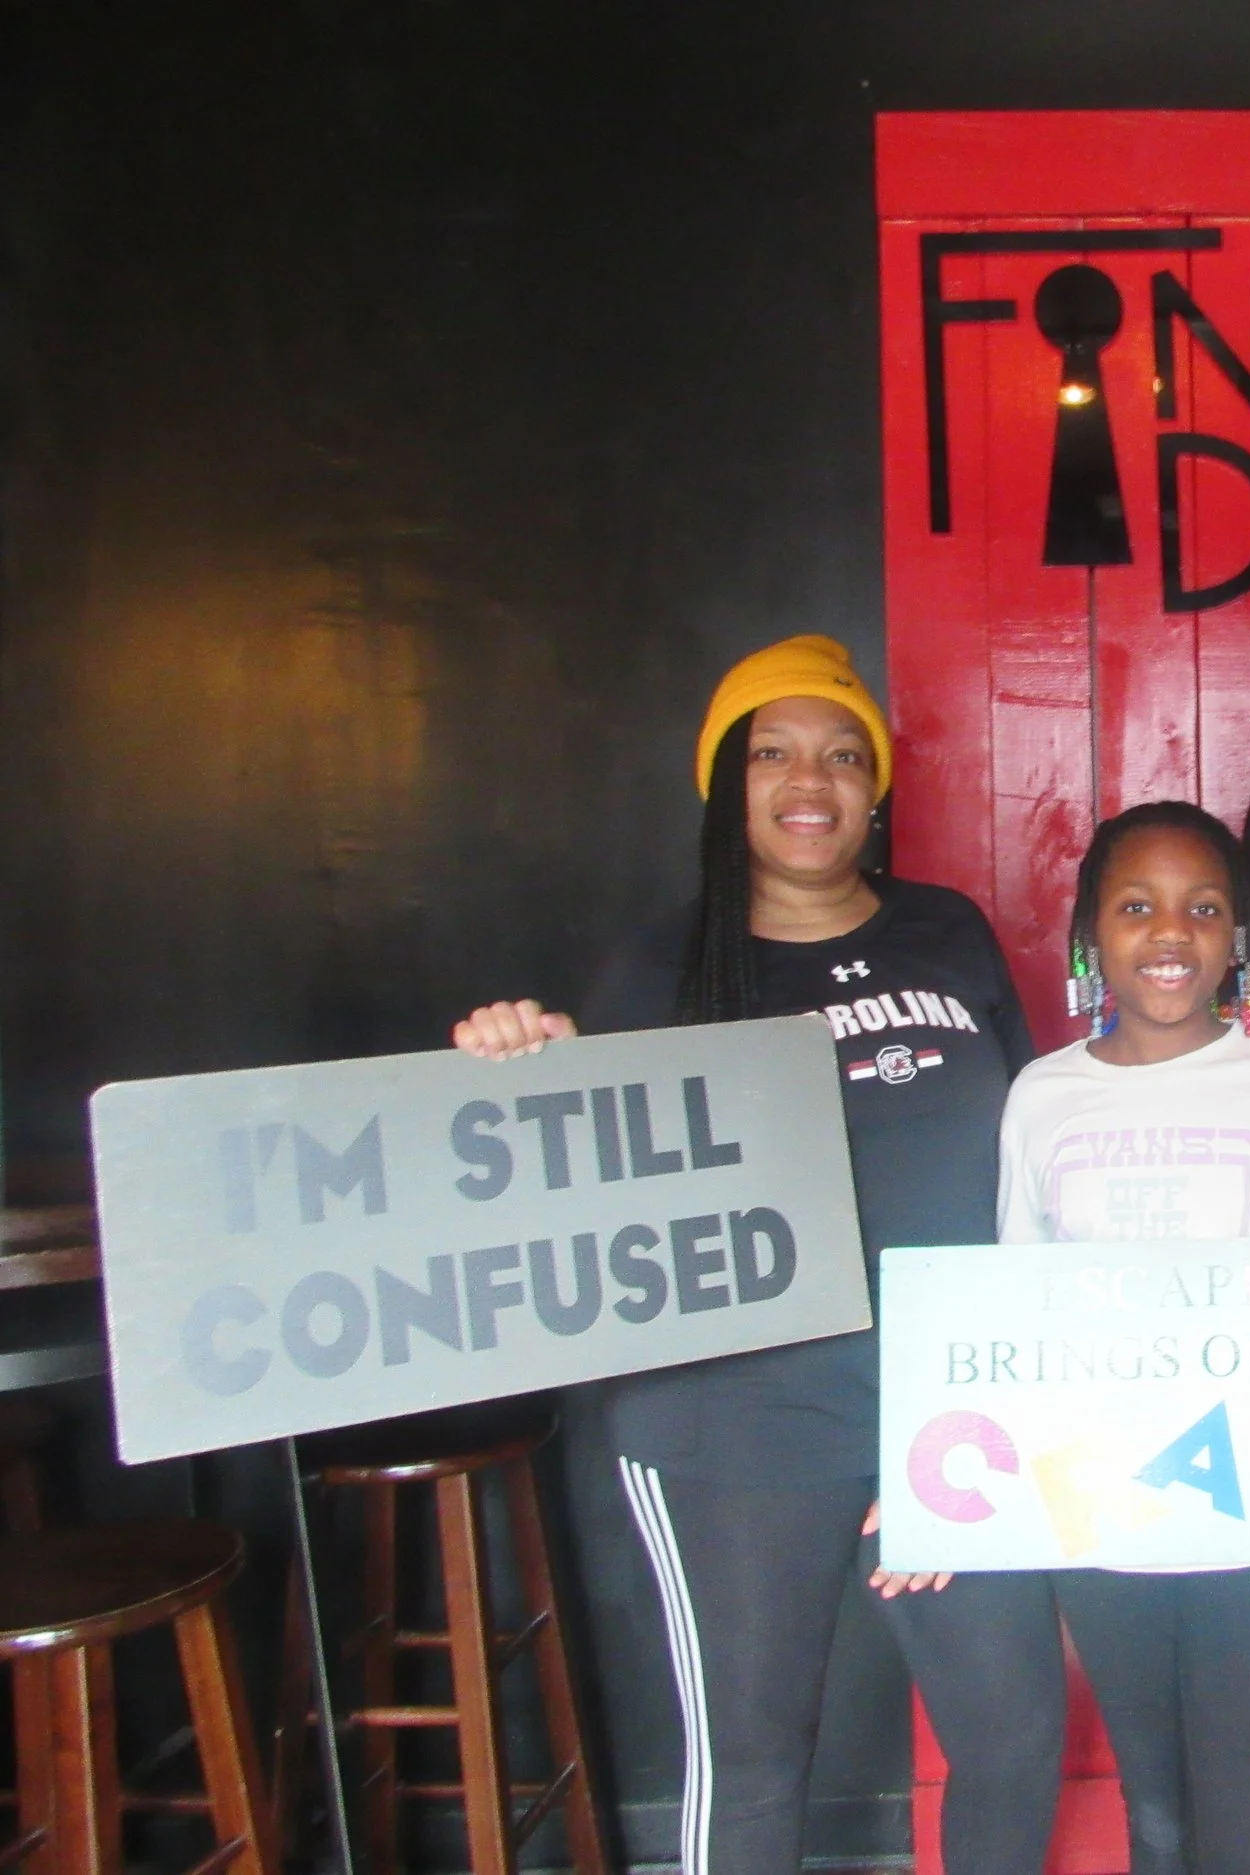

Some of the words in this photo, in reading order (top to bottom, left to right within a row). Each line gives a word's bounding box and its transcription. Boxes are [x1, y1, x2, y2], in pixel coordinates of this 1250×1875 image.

[825, 991, 979, 1039] ROLINA
[217, 1113, 387, 1235] I'M
[450, 1076, 742, 1202] STILL
[1085, 1127, 1217, 1167] VANS
[1107, 1175, 1189, 1210] OFF
[1109, 1210, 1187, 1241] THE
[181, 1206, 796, 1395] CONFUSED
[945, 1335, 1181, 1385] BRINGS
